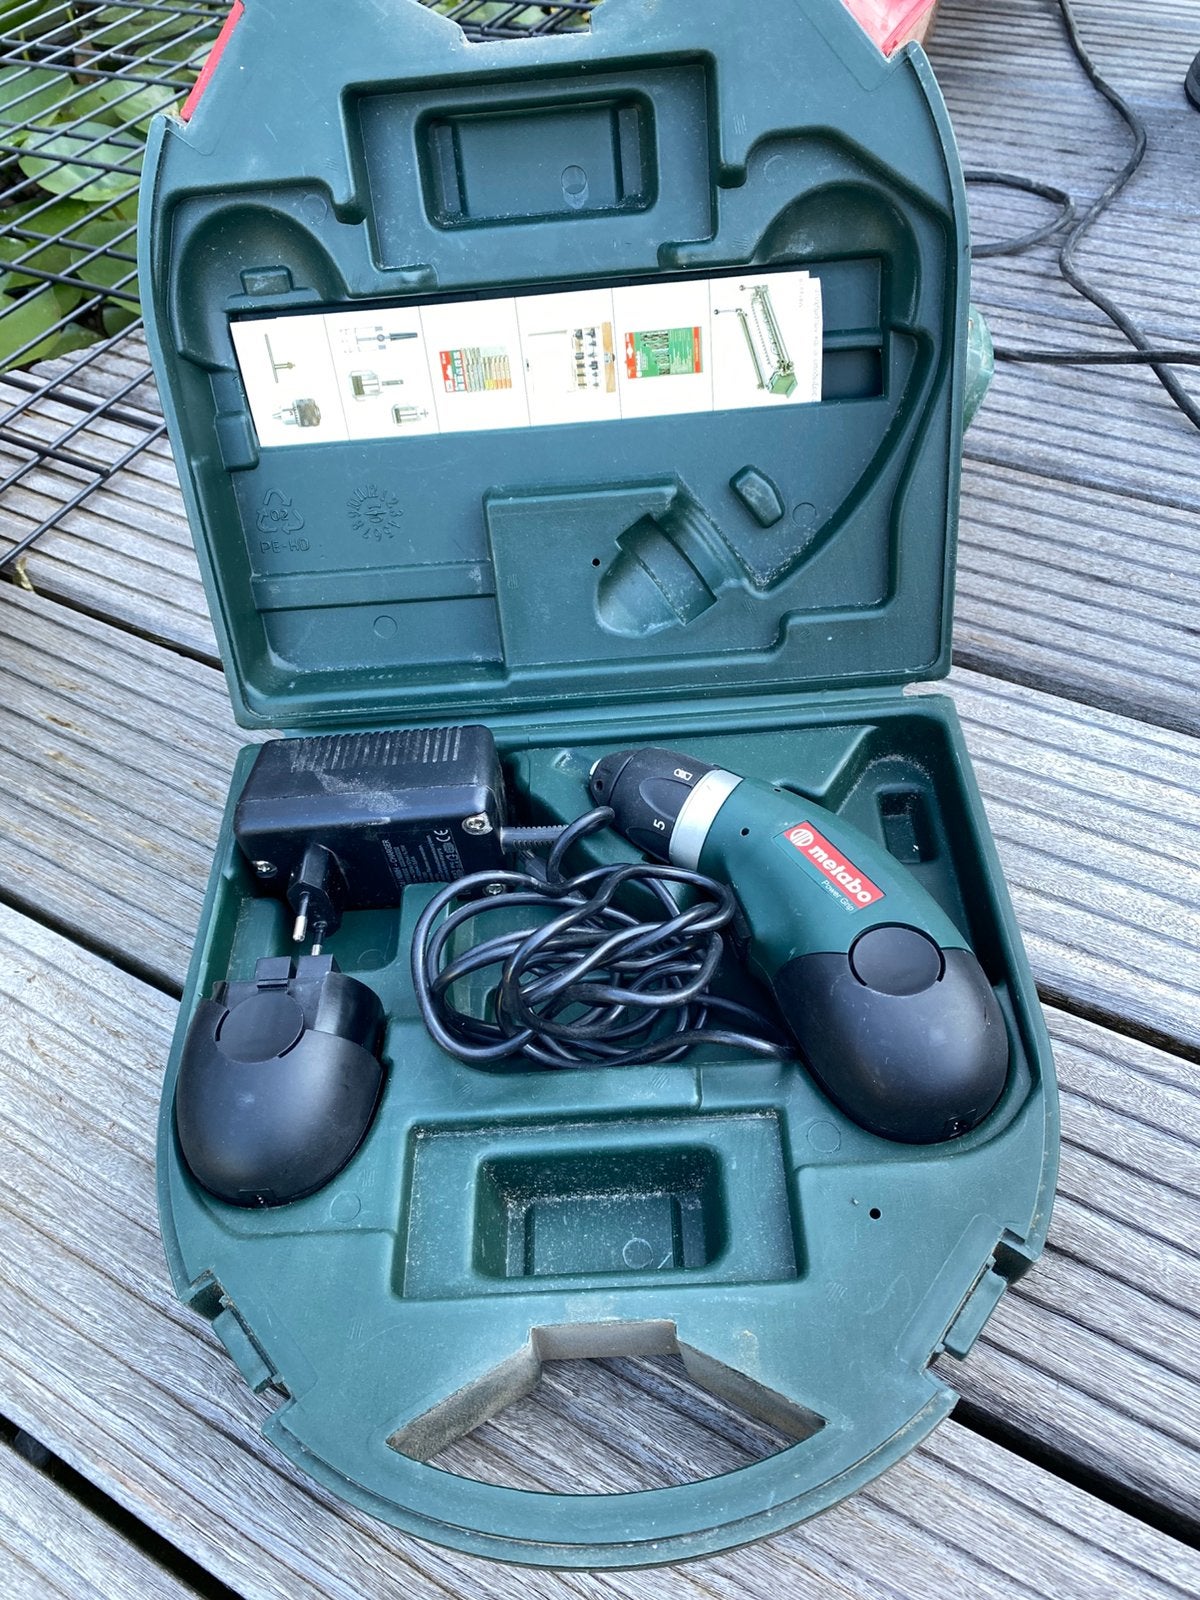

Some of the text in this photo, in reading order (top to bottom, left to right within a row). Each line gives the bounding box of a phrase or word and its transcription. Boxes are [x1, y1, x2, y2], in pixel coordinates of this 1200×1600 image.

[270, 509, 289, 521] 02
[260, 538, 311, 553] PE-HD
[653, 819, 665, 831] 5
[807, 845, 872, 903] metabo
[821, 879, 855, 912] Power Grip
